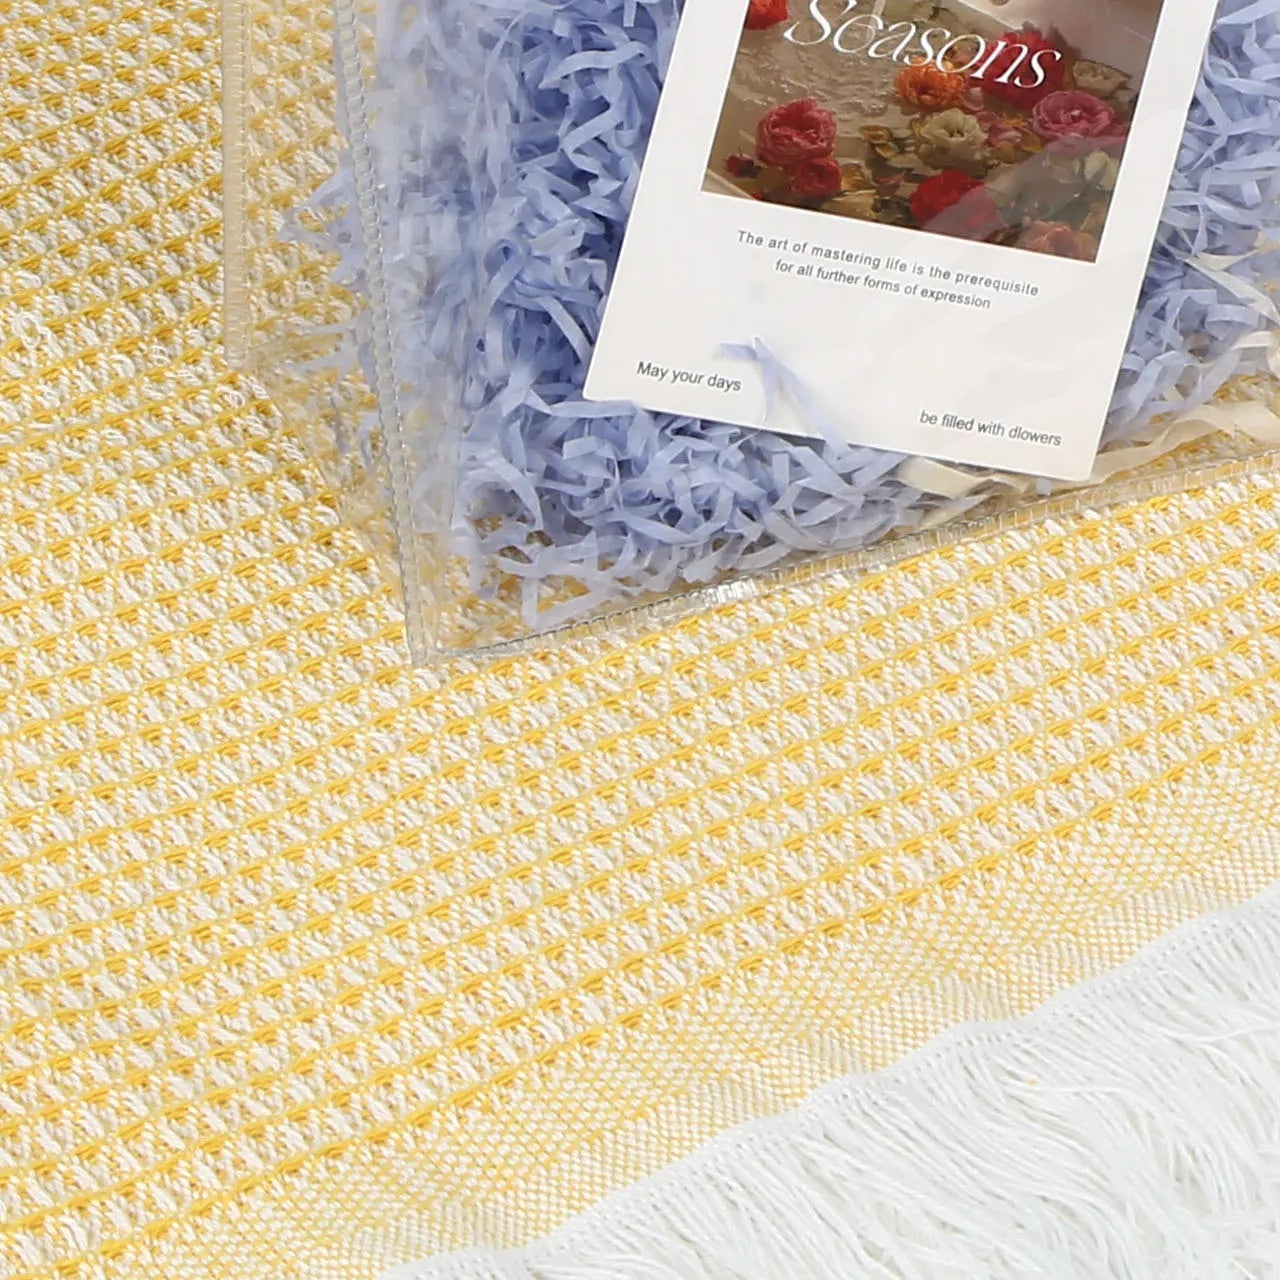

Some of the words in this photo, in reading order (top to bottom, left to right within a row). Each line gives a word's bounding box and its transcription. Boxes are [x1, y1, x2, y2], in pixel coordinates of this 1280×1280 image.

[737, 230, 763, 247] The
[768, 237, 789, 252] art
[792, 242, 808, 254] of
[811, 245, 881, 270] mastering
[885, 257, 908, 272] life
[911, 263, 925, 276] is
[928, 266, 951, 281] the
[955, 271, 1039, 297] prerequisite
[775, 259, 794, 274] for
[796, 264, 813, 277] all
[816, 267, 861, 286] further
[863, 275, 900, 293] forms
[903, 284, 919, 296] of
[920, 288, 991, 310] expression
[636, 360, 668, 381] May
[671, 370, 704, 389] your
[707, 373, 742, 393] days
[919, 409, 939, 426] be
[941, 414, 974, 432] filled
[976, 422, 1006, 439] with
[1008, 427, 1062, 447] dlowers
